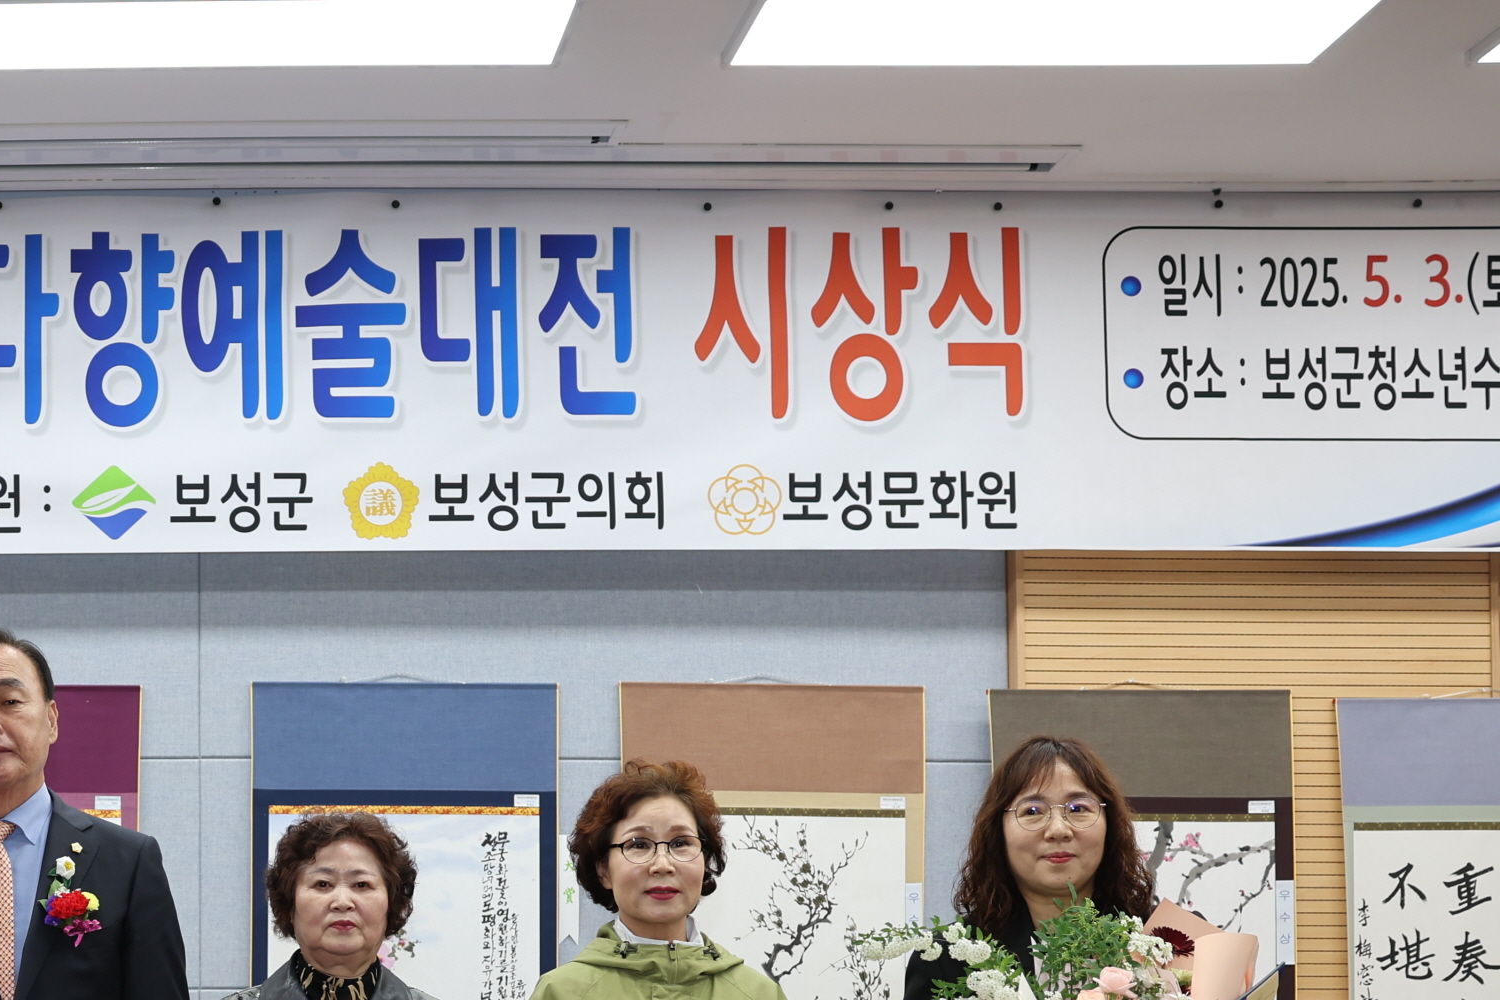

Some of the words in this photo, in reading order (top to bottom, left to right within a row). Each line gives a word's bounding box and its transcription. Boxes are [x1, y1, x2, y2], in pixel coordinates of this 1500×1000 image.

[1157, 253, 1222, 317] 일시
[1259, 256, 1349, 308] 2025.
[694, 226, 1025, 422] 시상식
[1160, 346, 1227, 410] 장소
[1262, 345, 1500, 411] 보성군청소년수
[170, 472, 314, 533] 보성군
[428, 470, 666, 531] 보성군의회
[782, 470, 1019, 531] 보성문화원
